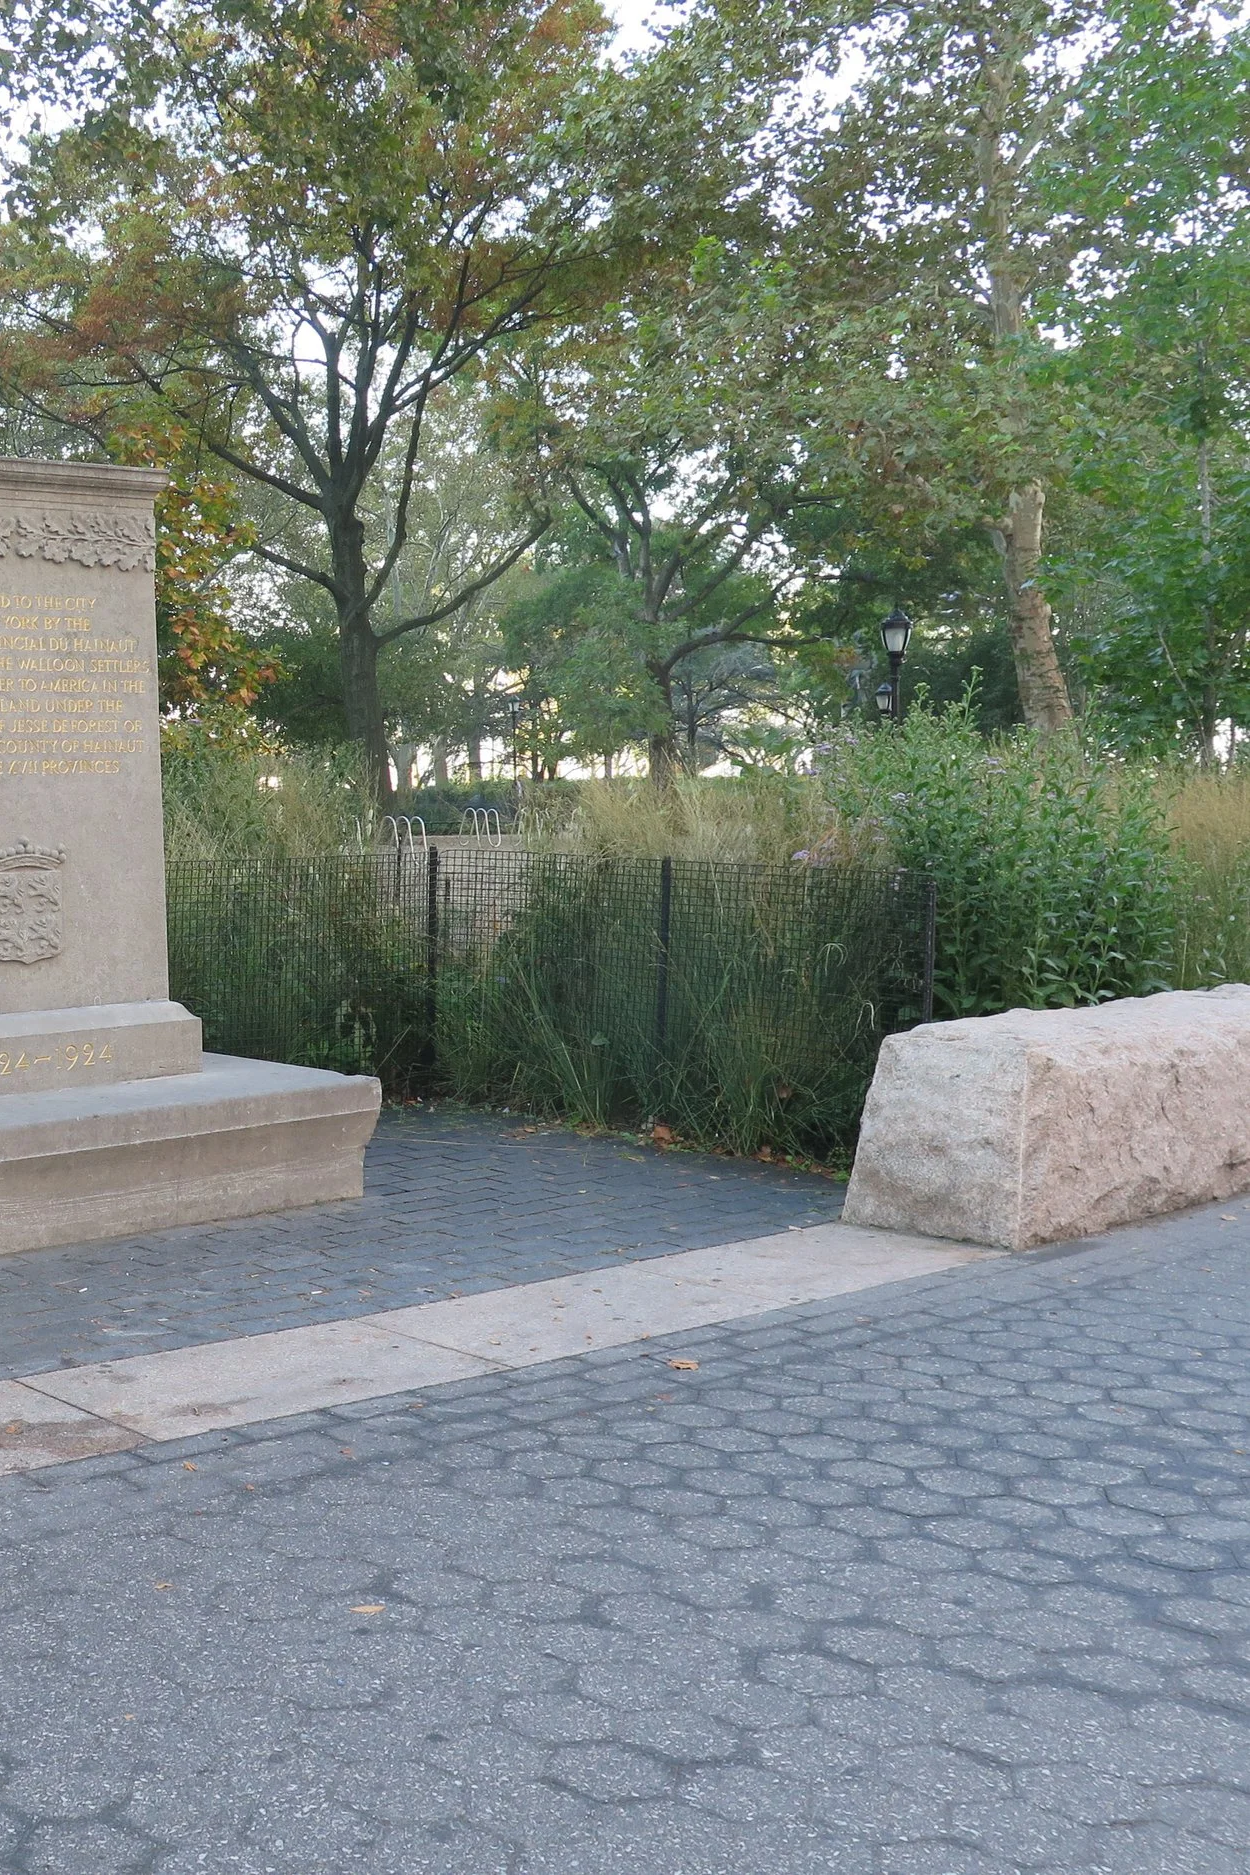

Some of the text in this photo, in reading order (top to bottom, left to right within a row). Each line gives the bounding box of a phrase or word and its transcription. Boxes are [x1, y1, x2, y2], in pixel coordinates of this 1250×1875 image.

[13, 594, 32, 609] TO
[35, 595, 62, 610] THE
[65, 596, 97, 612] CITY
[2, 615, 38, 630] YORK
[44, 617, 62, 630] BY
[64, 618, 91, 632] THE
[50, 637, 69, 650] DU
[74, 638, 137, 653] HAINAUT
[17, 658, 85, 672] WALLOON
[90, 660, 150, 674] SETTLERS
[18, 678, 36, 692] TO
[40, 679, 99, 693] AMERICA
[103, 679, 118, 693] IN
[121, 679, 146, 693] THE
[45, 699, 94, 713] UNDER
[97, 699, 123, 714] THE
[9, 720, 48, 733] JESSE
[52, 720, 71, 733] DE
[71, 720, 120, 733] FOREST
[123, 720, 143, 733] OF
[61, 740, 79, 753] OF
[83, 740, 144, 754] HAINAUT
[42, 760, 120, 776] PROVINCES
